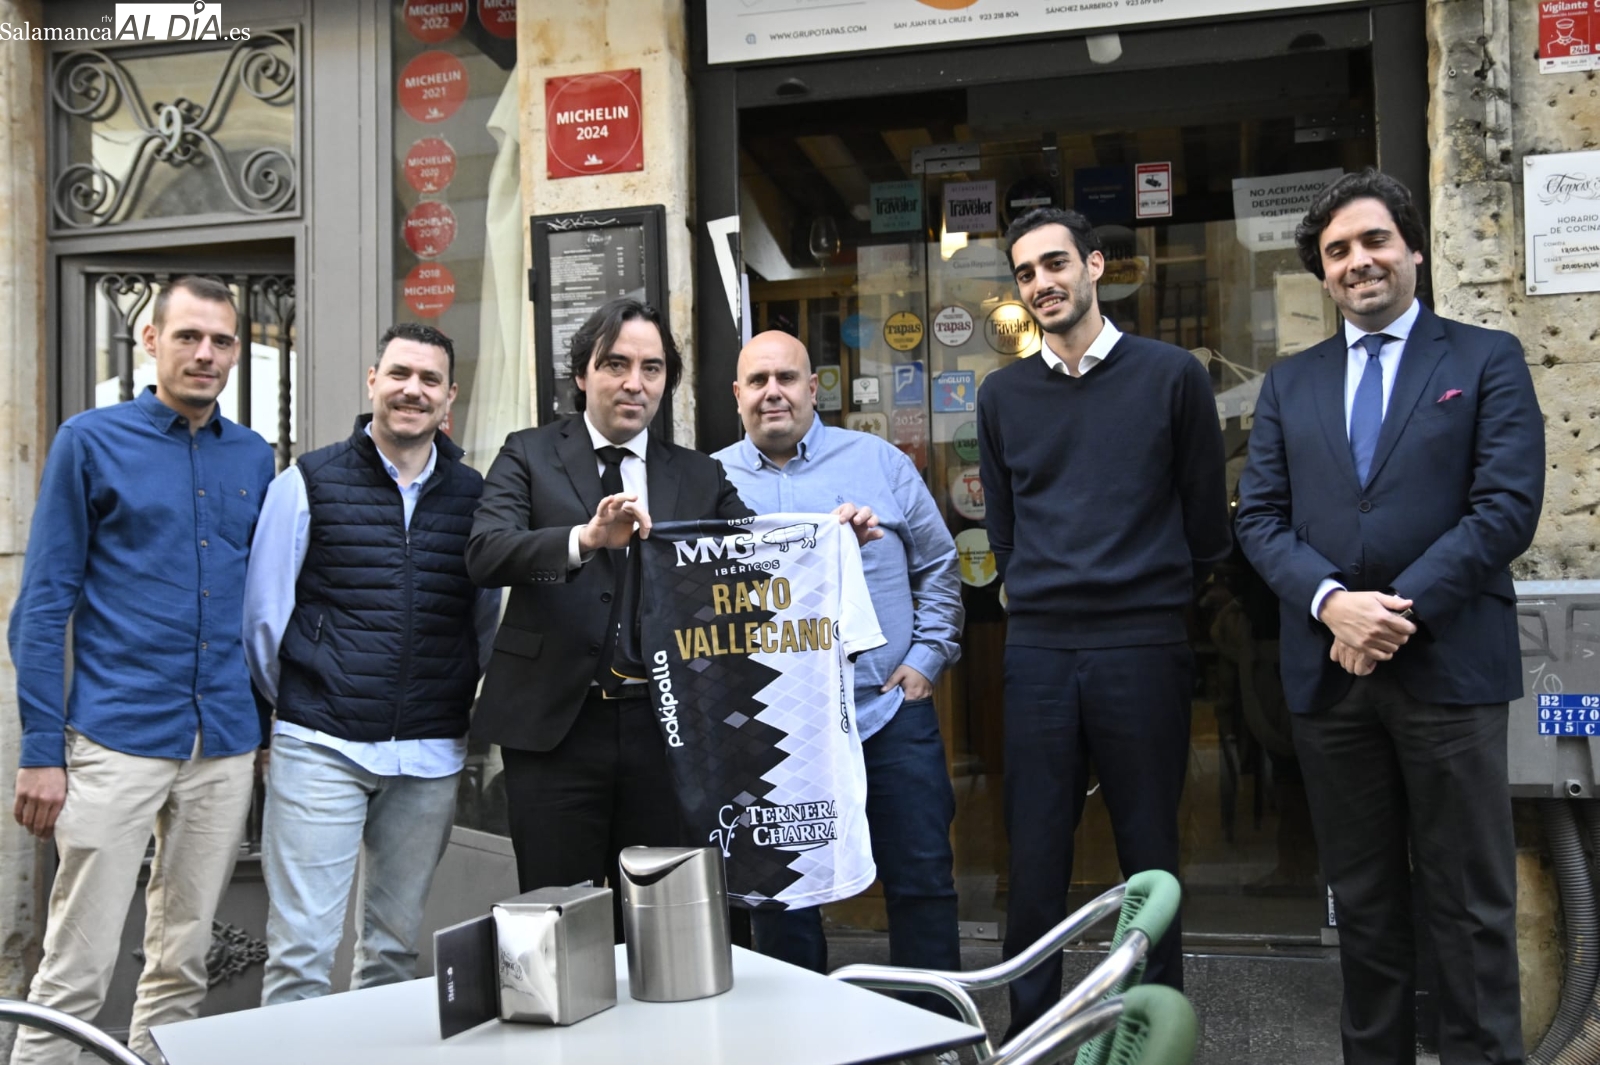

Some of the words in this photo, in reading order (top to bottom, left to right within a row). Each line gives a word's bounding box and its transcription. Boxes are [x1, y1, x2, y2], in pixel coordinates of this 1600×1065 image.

[408, 3, 463, 16] MICHELIN
[1542, 0, 1589, 14] Vigilante
[421, 17, 449, 30] 2022
[769, 25, 867, 41] WWW.GRUPOTAPAS.COM
[405, 71, 462, 89] MICHELIN
[422, 86, 447, 100] 2021
[556, 105, 629, 126] MICHELIN
[576, 124, 609, 141] 2024
[408, 154, 452, 167] MICHELIN
[1249, 188, 1265, 198] NO
[947, 197, 993, 218] Traveler
[1252, 195, 1311, 208] DESPEDIDAS
[407, 215, 453, 228] MICHELIN
[1557, 214, 1599, 225] HORARIO
[1550, 226, 1562, 236] DE
[418, 268, 441, 280] 2018
[404, 284, 456, 297] MICHELIN
[989, 318, 1031, 336] Traveler
[672, 532, 756, 567] MMG
[715, 560, 780, 577] IBÉRICOS
[712, 577, 791, 615] RAYO
[675, 617, 832, 660] VALLECANO
[652, 650, 684, 748] pakipalla
[1540, 695, 1559, 707] B2
[1581, 695, 1600, 708] 02
[1584, 723, 1595, 735] C
